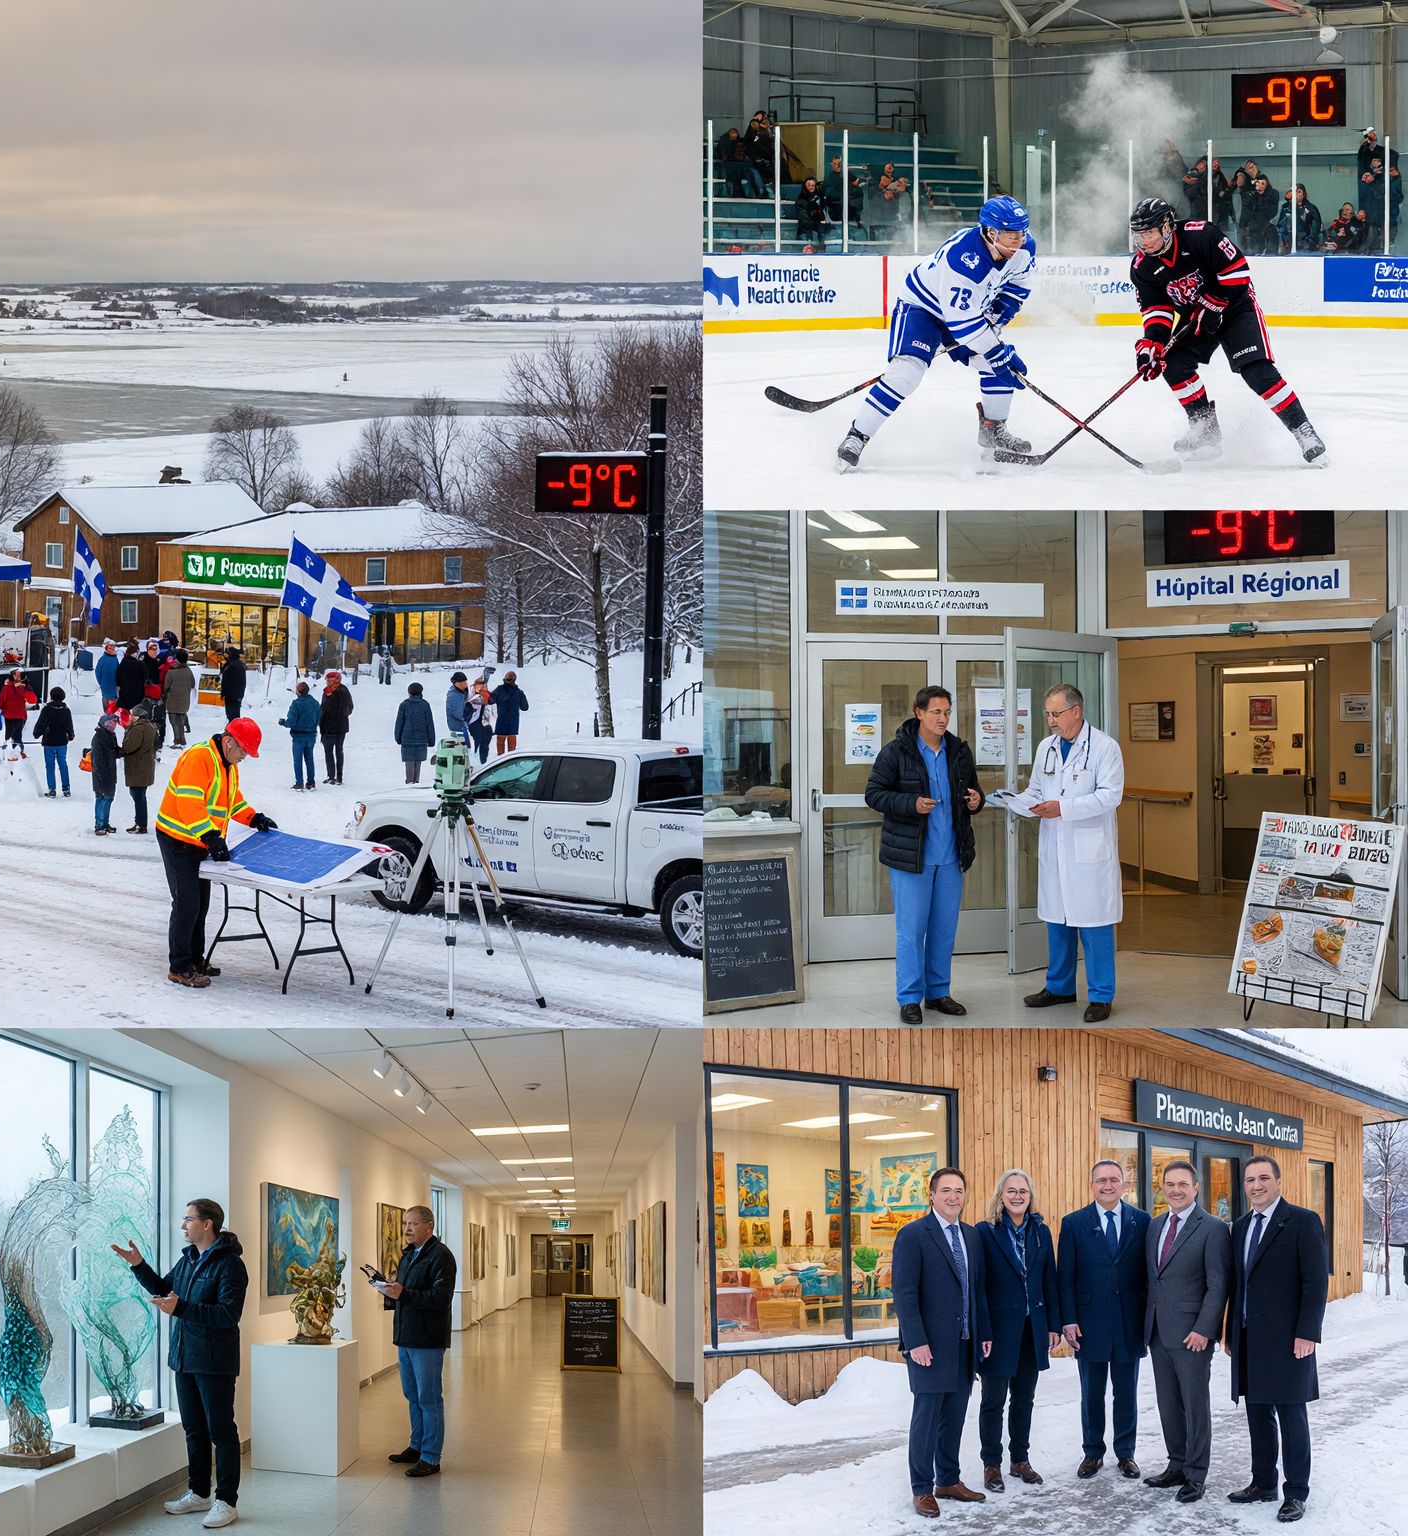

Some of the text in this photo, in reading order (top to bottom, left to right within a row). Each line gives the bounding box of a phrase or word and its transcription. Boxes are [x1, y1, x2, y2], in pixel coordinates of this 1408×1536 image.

[1246, 75, 1334, 121] -9°C
[547, 463, 637, 508] -9°C
[1242, 568, 1340, 598] Régional
[1156, 1092, 1233, 1132] Pharmacie
[1234, 1111, 1265, 1138] Jean
